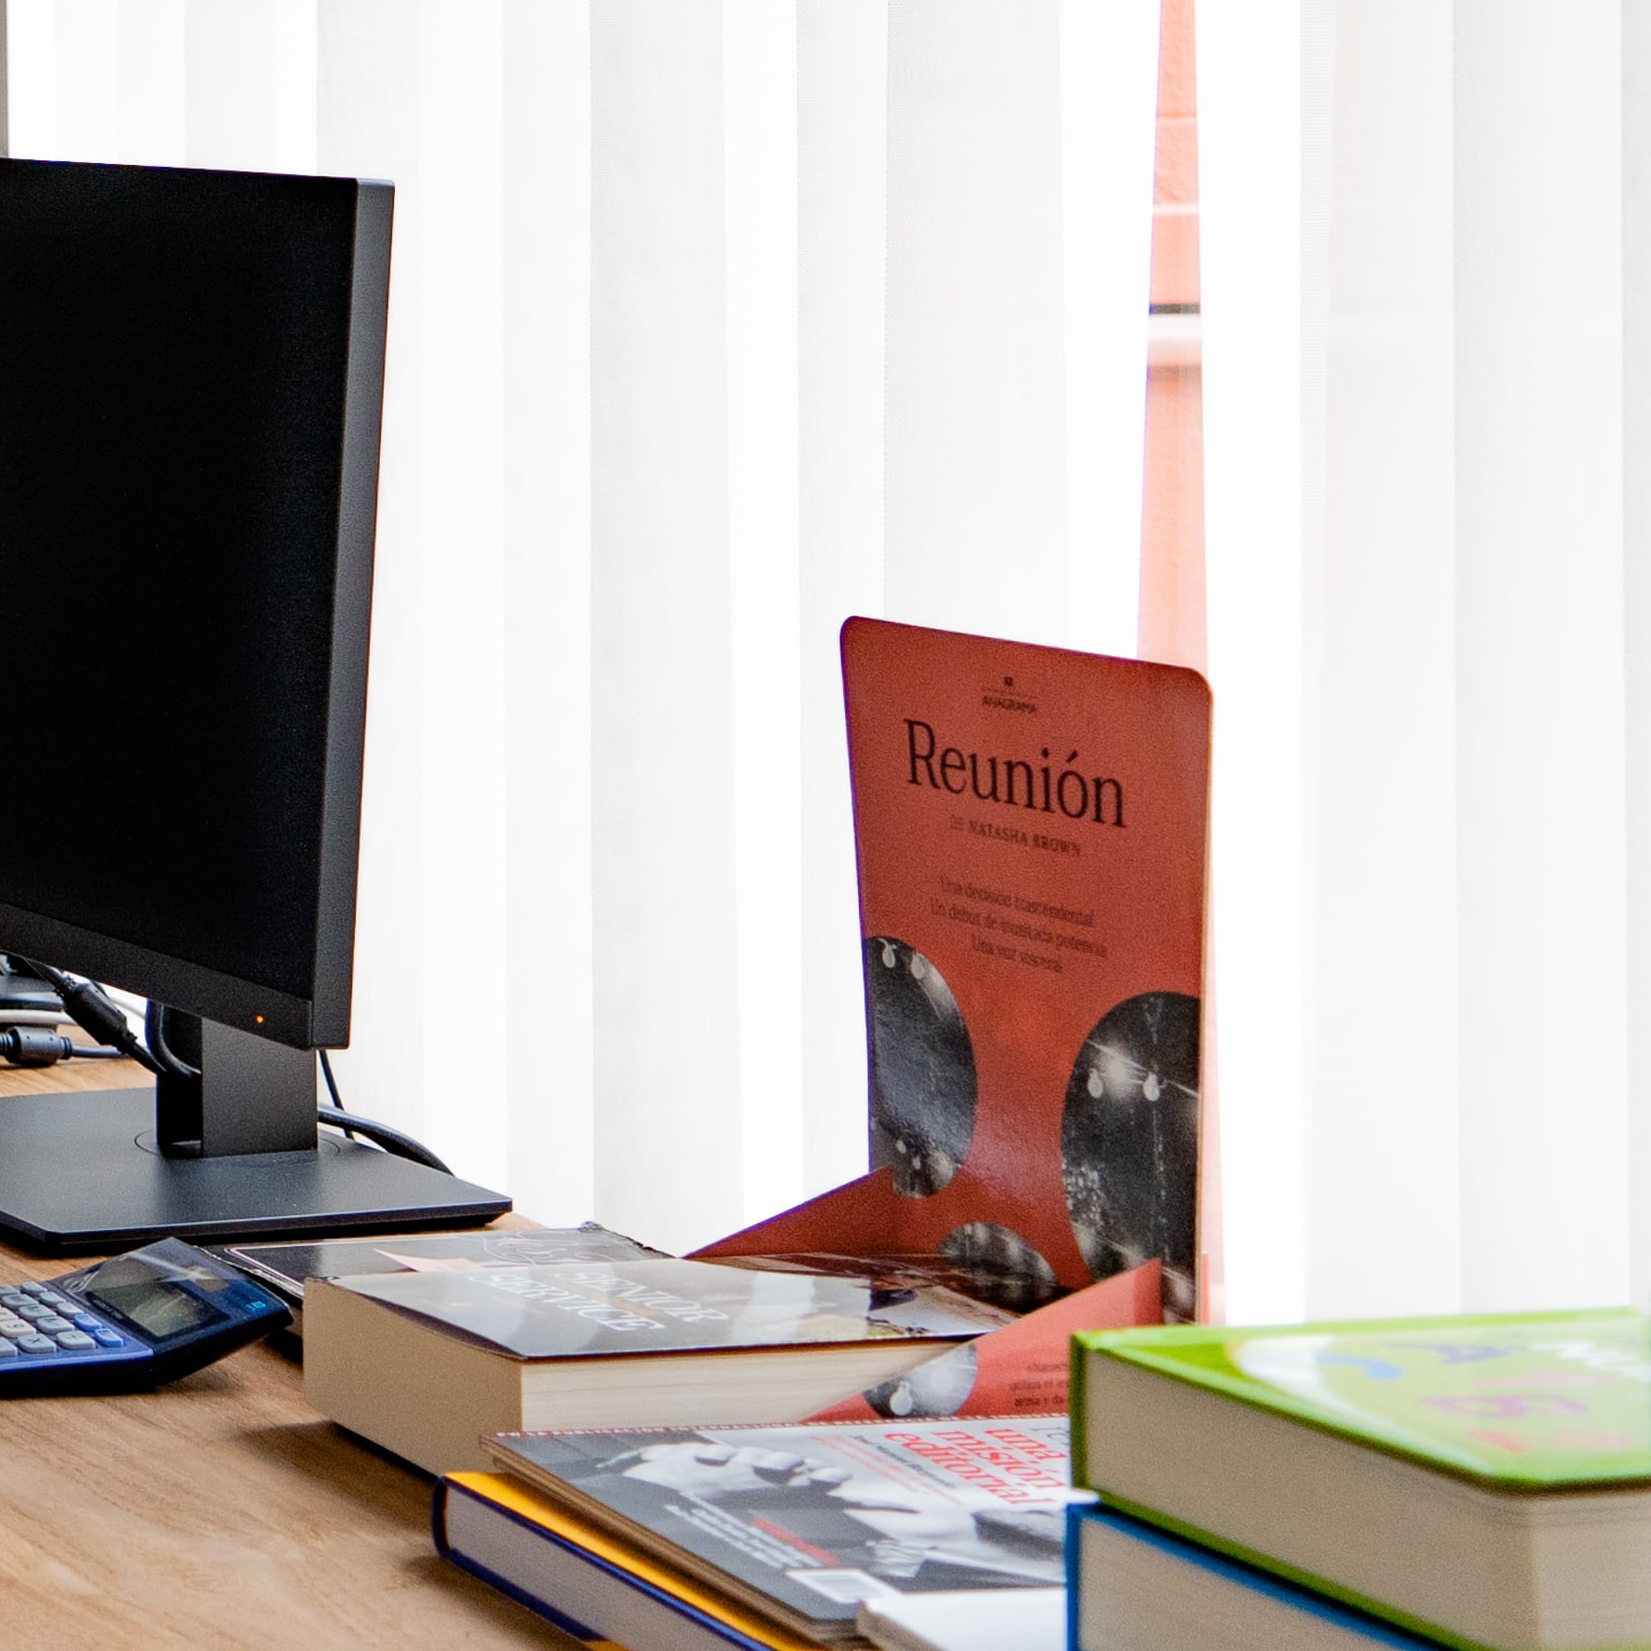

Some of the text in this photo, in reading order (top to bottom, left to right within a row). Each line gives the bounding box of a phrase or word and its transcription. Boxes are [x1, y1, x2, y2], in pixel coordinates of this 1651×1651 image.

[902, 717, 1129, 829] Reunión
[969, 818, 1029, 848] NATASHA
[1033, 832, 1082, 858] BROWN
[467, 1270, 668, 1332] SERVICE
[553, 1270, 730, 1323] SENIOR
[883, 1432, 1059, 1505] editorial
